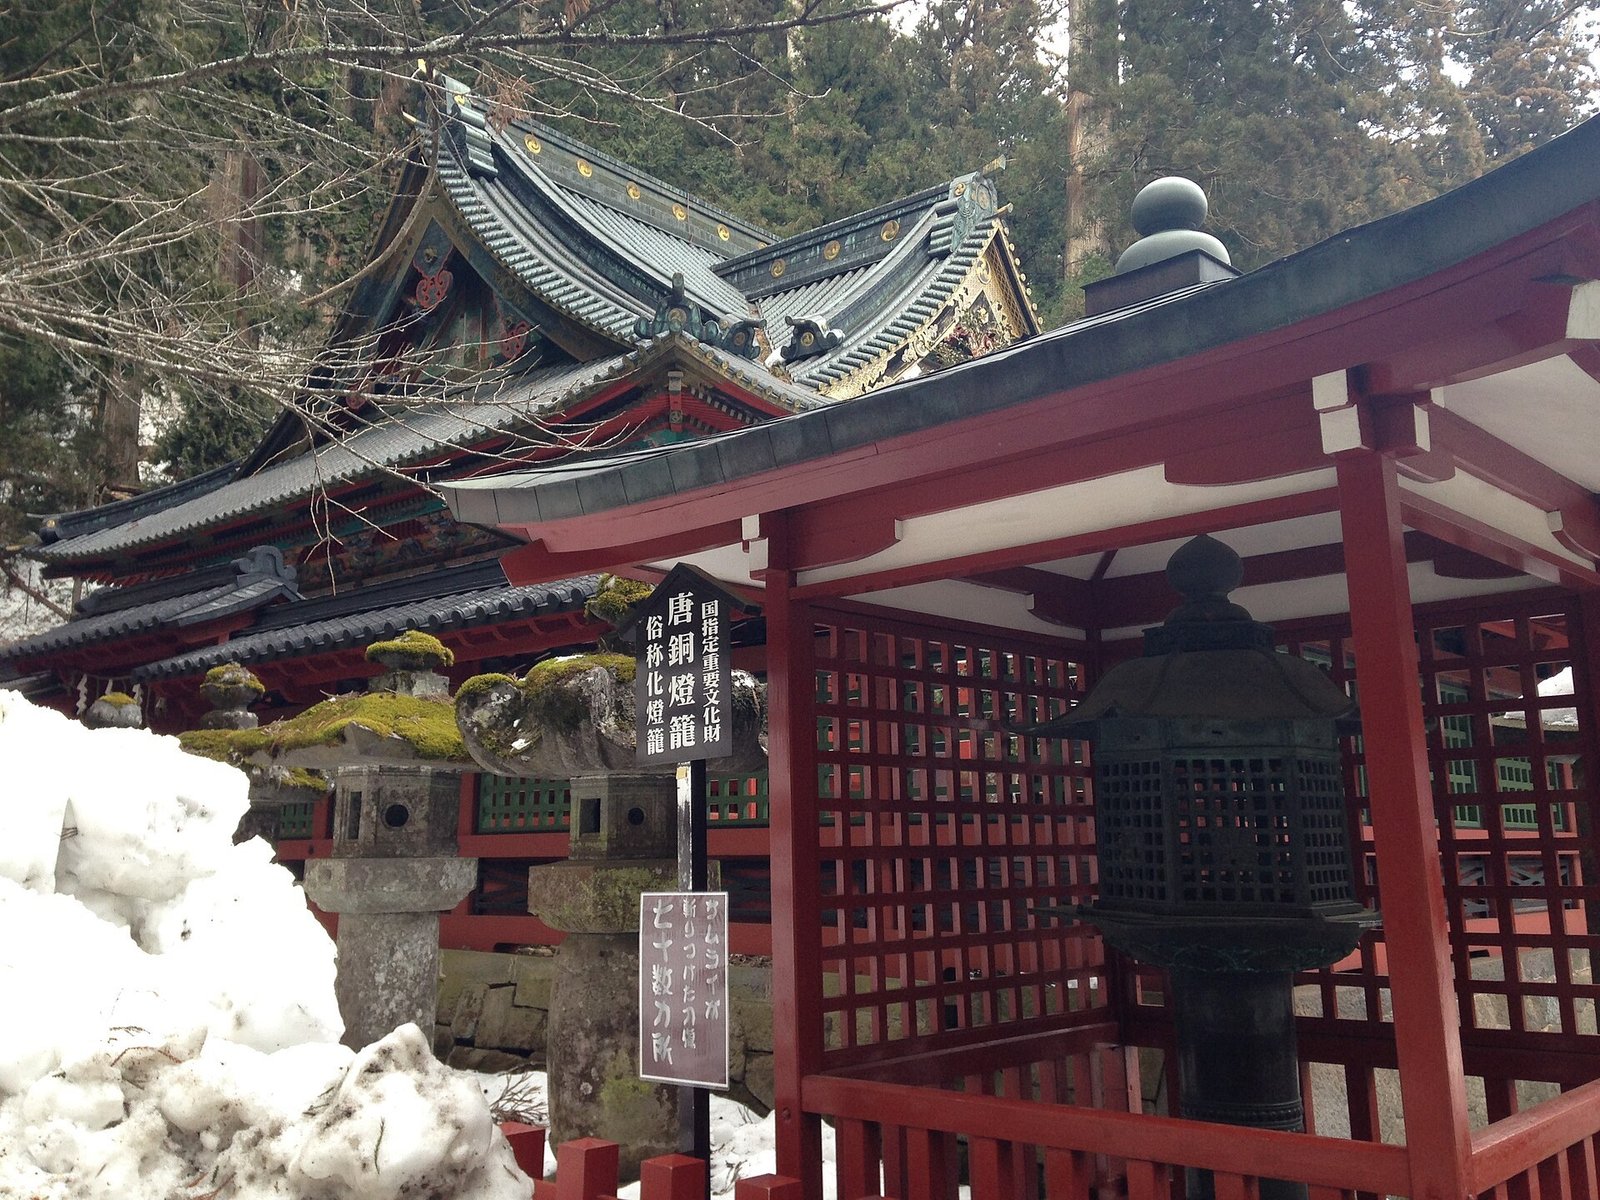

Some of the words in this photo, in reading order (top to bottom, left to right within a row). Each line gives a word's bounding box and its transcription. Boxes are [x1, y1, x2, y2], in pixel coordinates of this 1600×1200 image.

[646, 615, 664, 756] 俗称化燈籠
[668, 591, 696, 750] 唐銅燈籠
[701, 600, 720, 744] 国指定重要文化財
